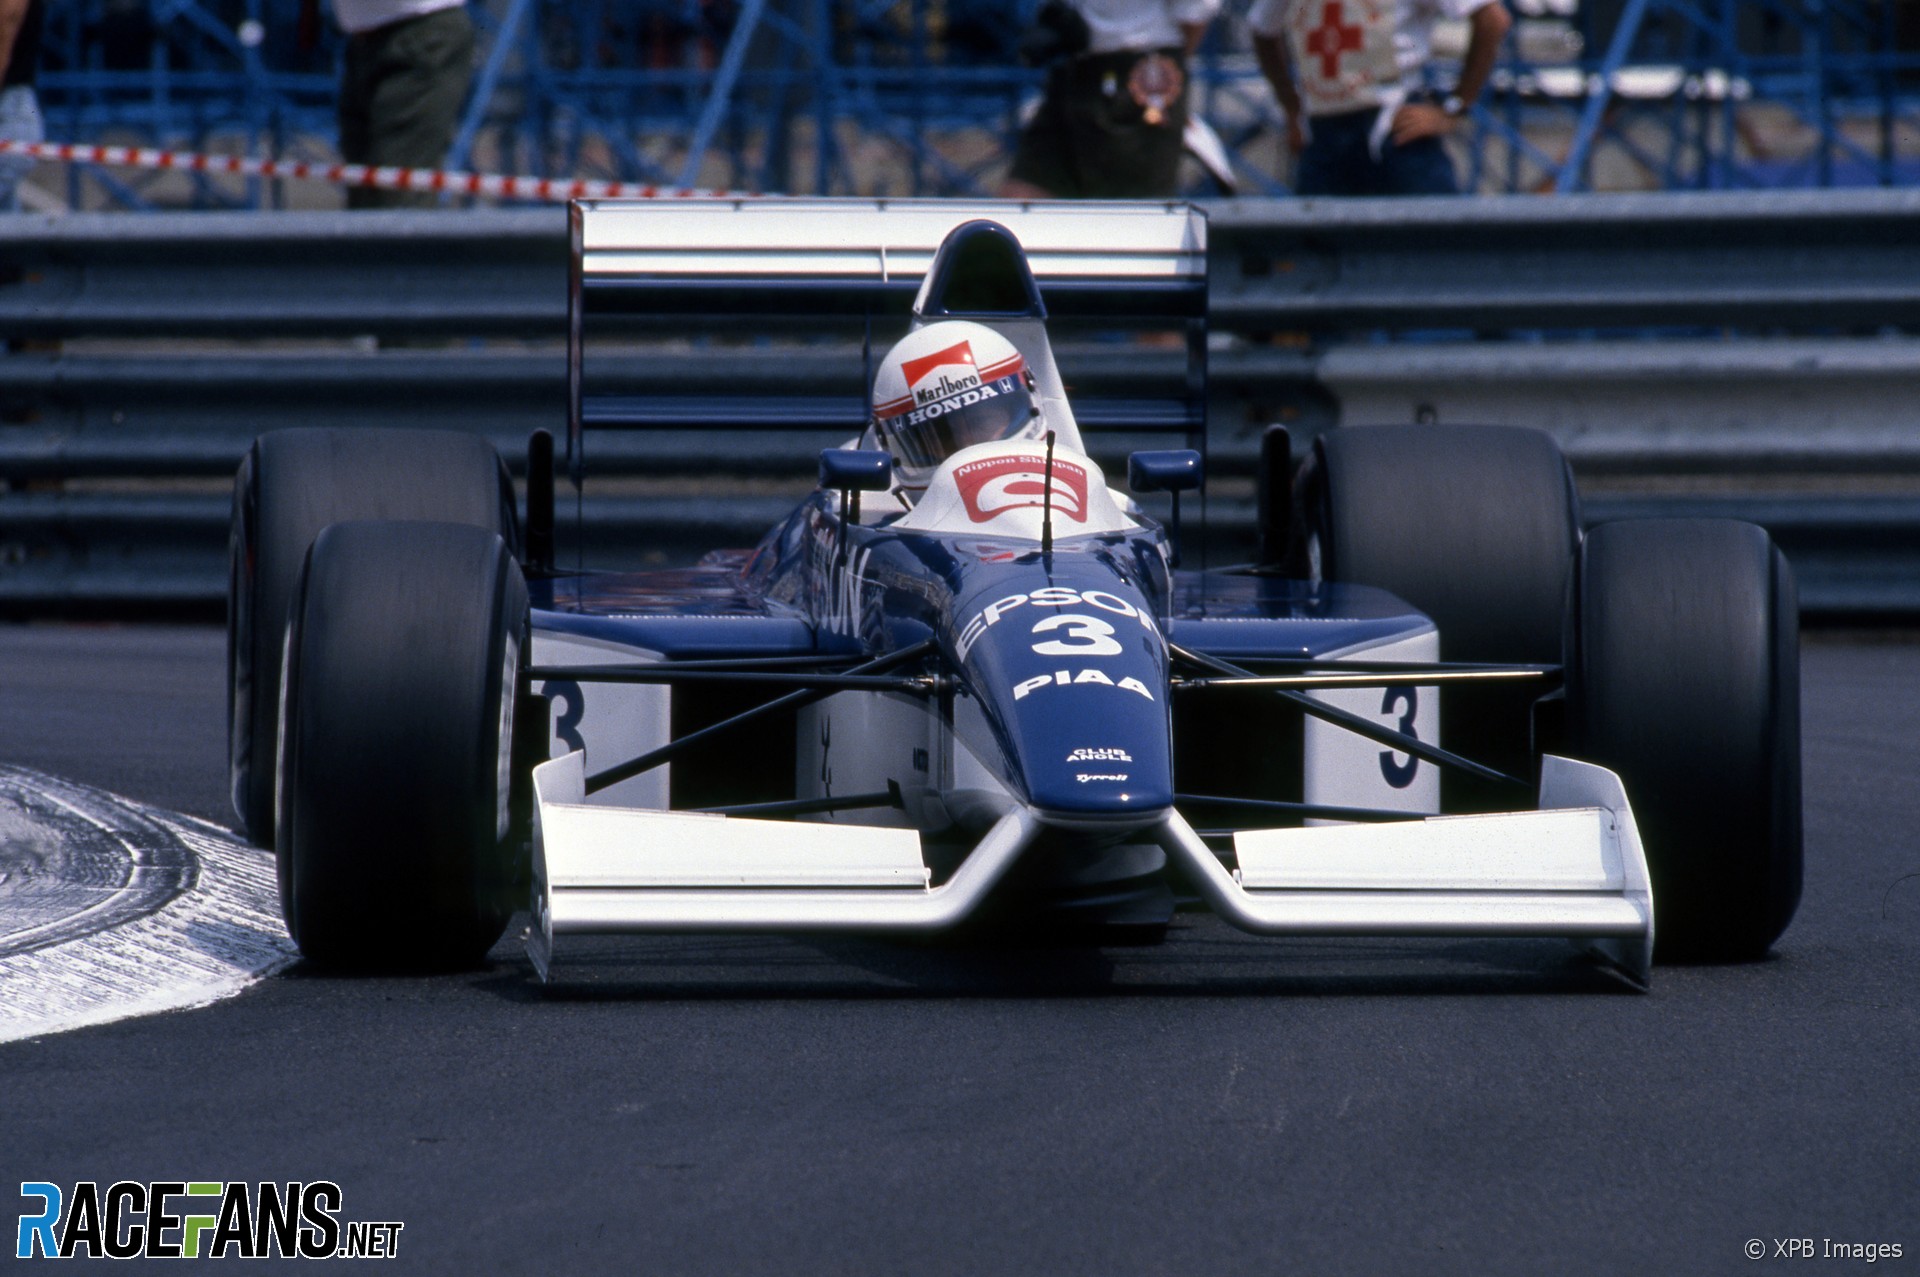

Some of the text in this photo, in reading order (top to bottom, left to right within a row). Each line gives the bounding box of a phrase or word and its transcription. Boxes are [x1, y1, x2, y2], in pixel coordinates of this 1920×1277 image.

[908, 385, 998, 426] HONDA
[916, 375, 978, 404] Marlboro
[958, 457, 1015, 477] Nippon
[1031, 614, 1123, 656] 3
[1013, 668, 1155, 701] PIAA
[541, 680, 587, 769] 3
[1379, 686, 1419, 789] 3
[1066, 754, 1133, 762] ANGLE
[1073, 748, 1126, 756] CLUB
